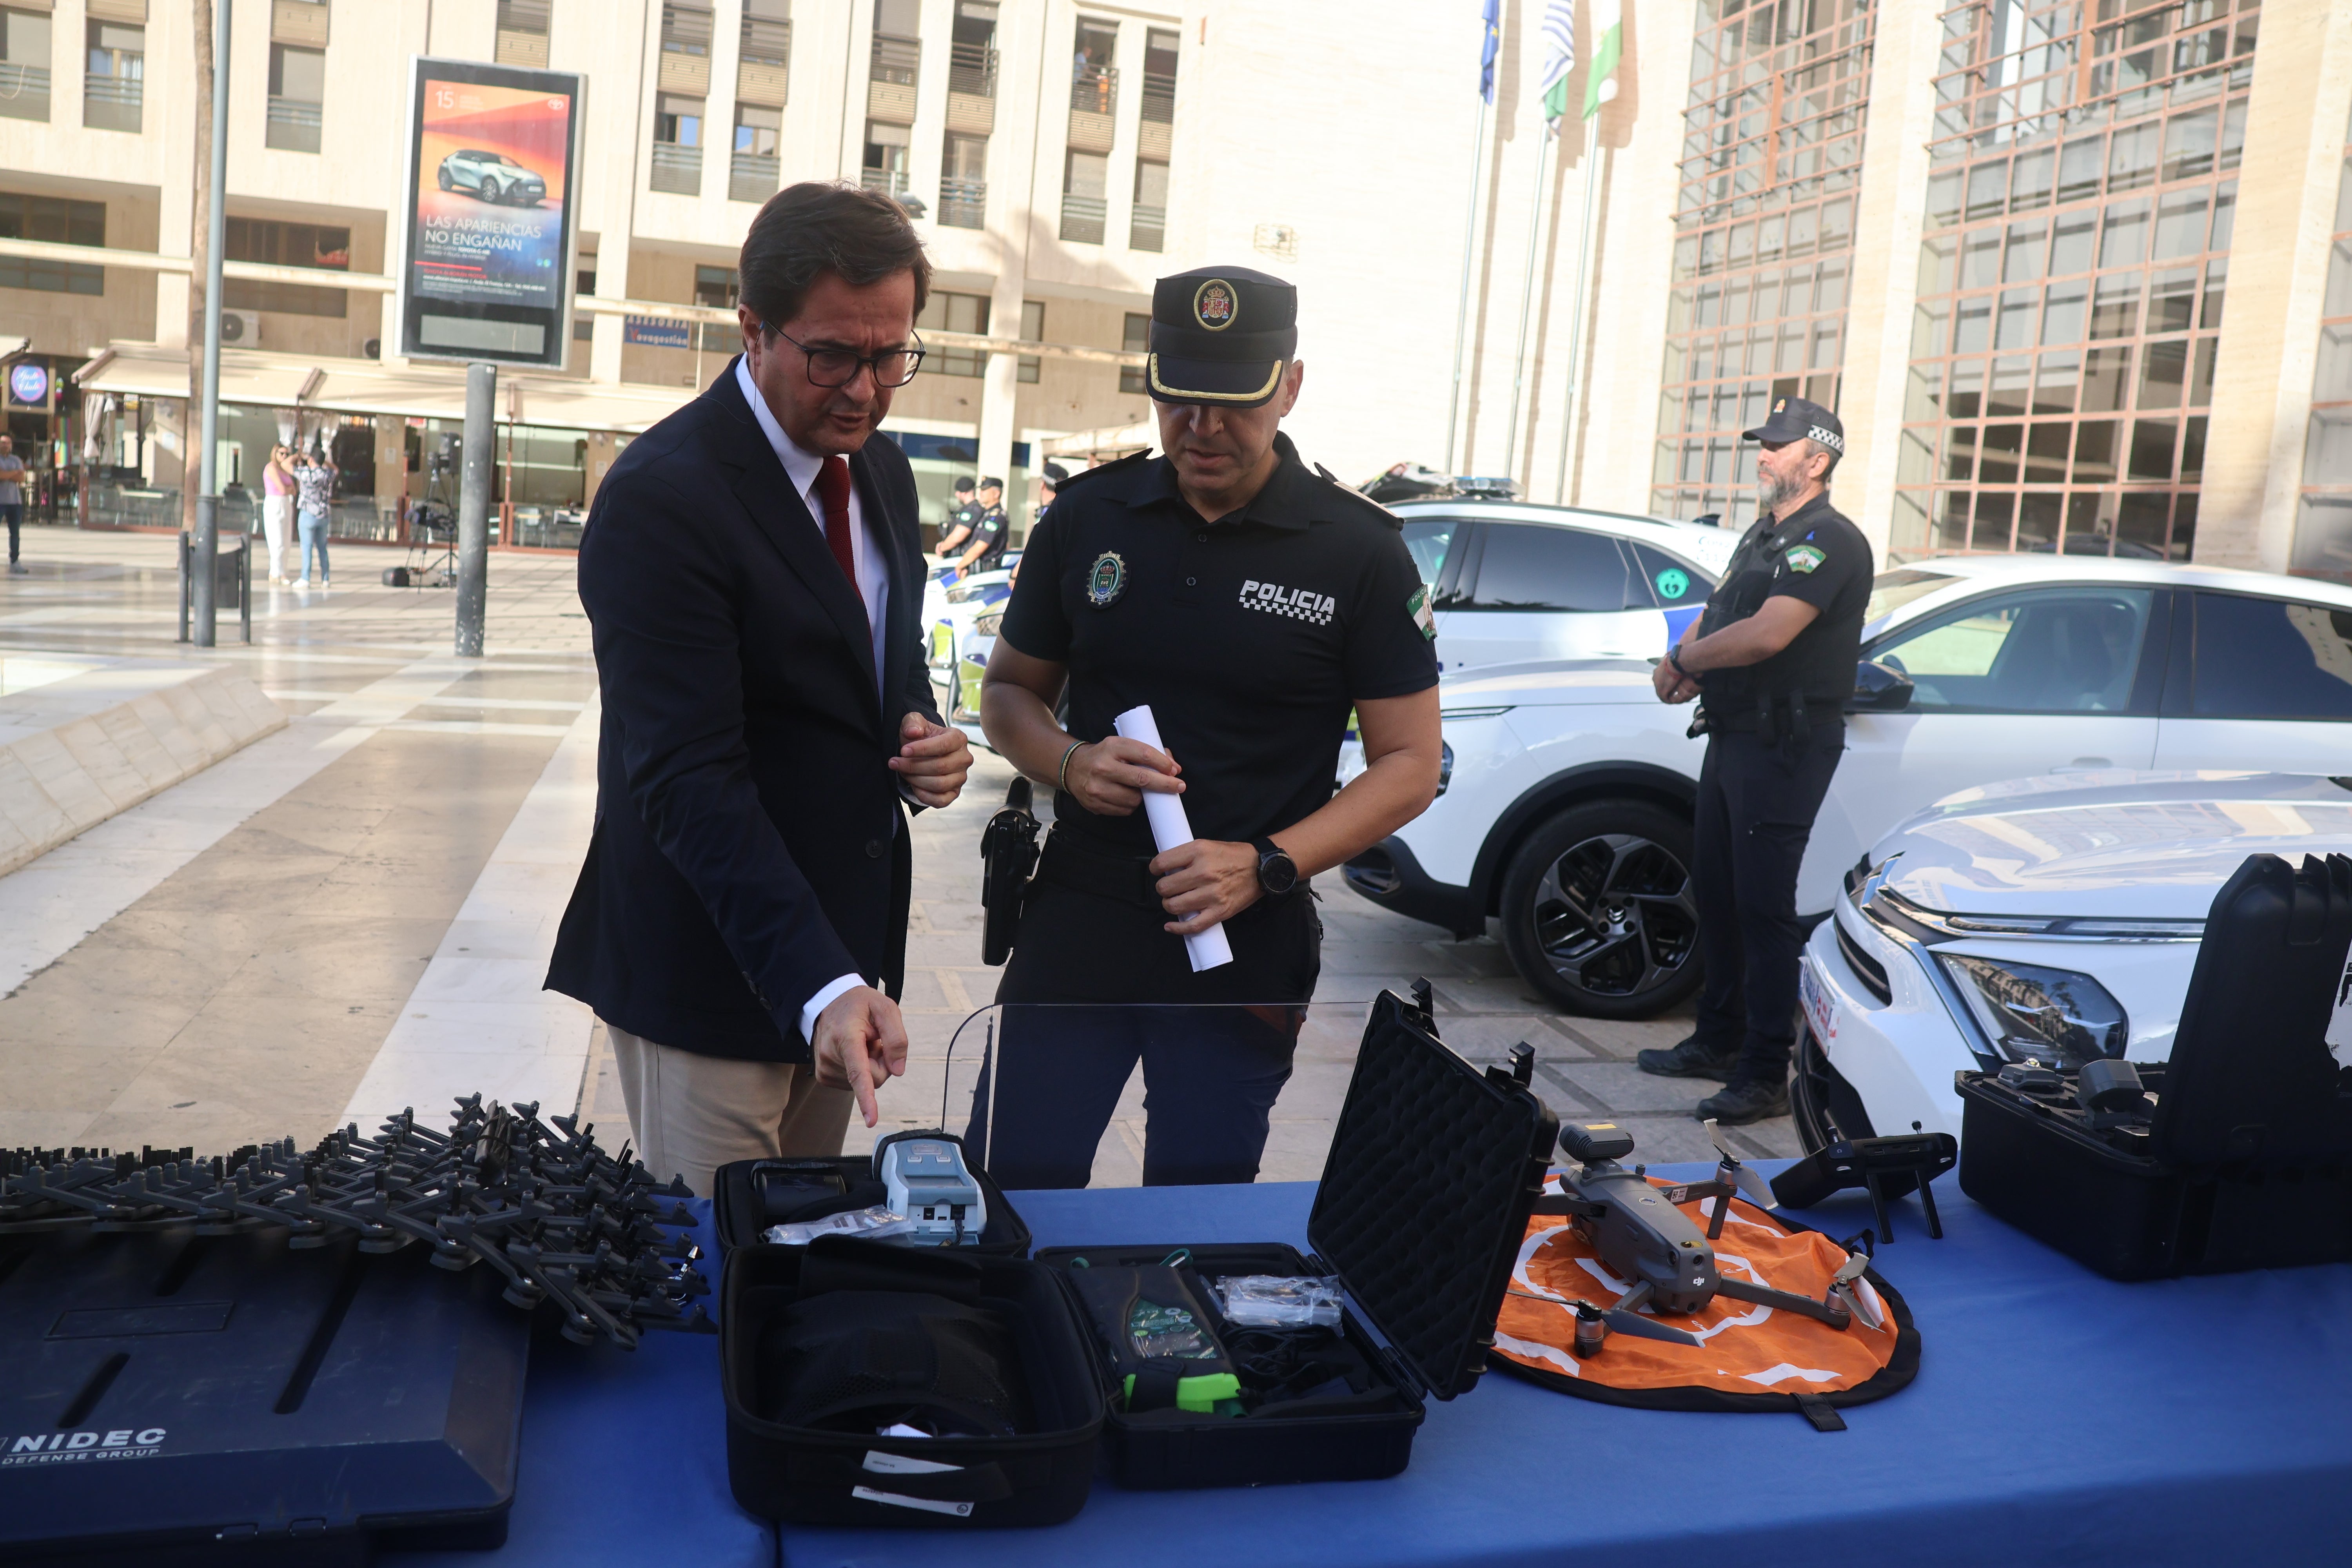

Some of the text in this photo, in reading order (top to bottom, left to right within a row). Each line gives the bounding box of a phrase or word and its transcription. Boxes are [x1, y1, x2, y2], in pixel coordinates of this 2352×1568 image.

[436, 90, 454, 109] 15
[426, 214, 542, 239] LAS APARIENCIAS
[425, 229, 522, 251] NO ENGAÑAN
[1240, 580, 1335, 615] POLICIA
[11, 1428, 166, 1452] NIDEC
[1, 1448, 160, 1465] DEFENSE GROUP
